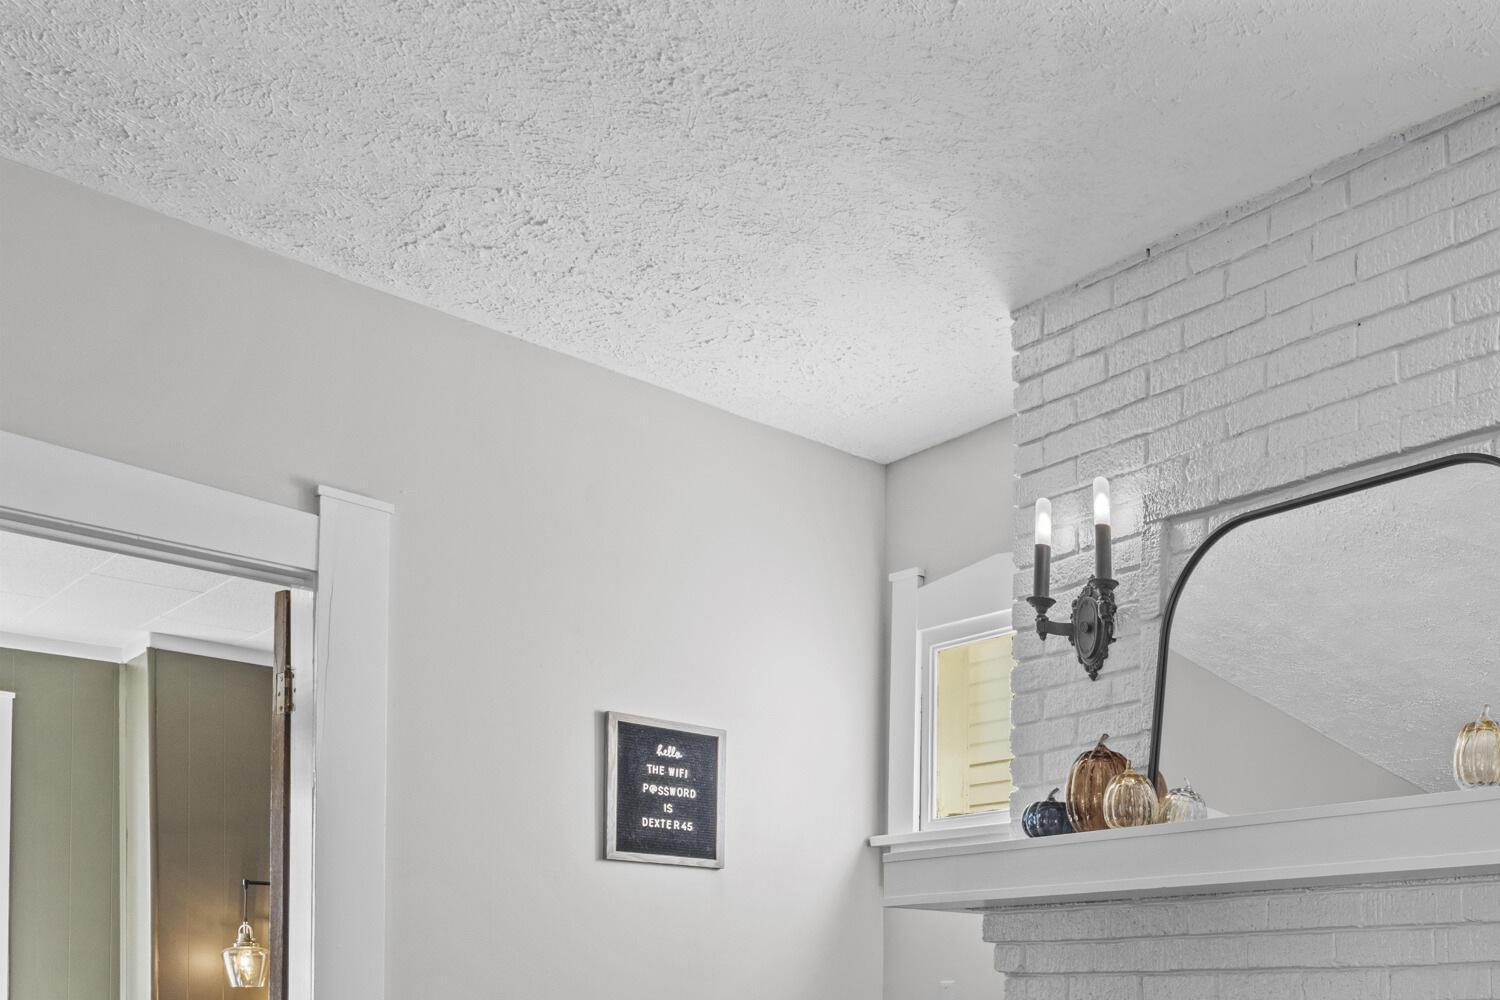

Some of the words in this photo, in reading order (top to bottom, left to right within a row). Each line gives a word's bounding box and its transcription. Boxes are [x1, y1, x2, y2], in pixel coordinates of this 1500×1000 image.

[656, 744, 683, 759] hello
[646, 764, 665, 775] THE
[668, 767, 688, 779] WIFI
[642, 783, 697, 799] P@SSWORD
[663, 803, 673, 813] IS
